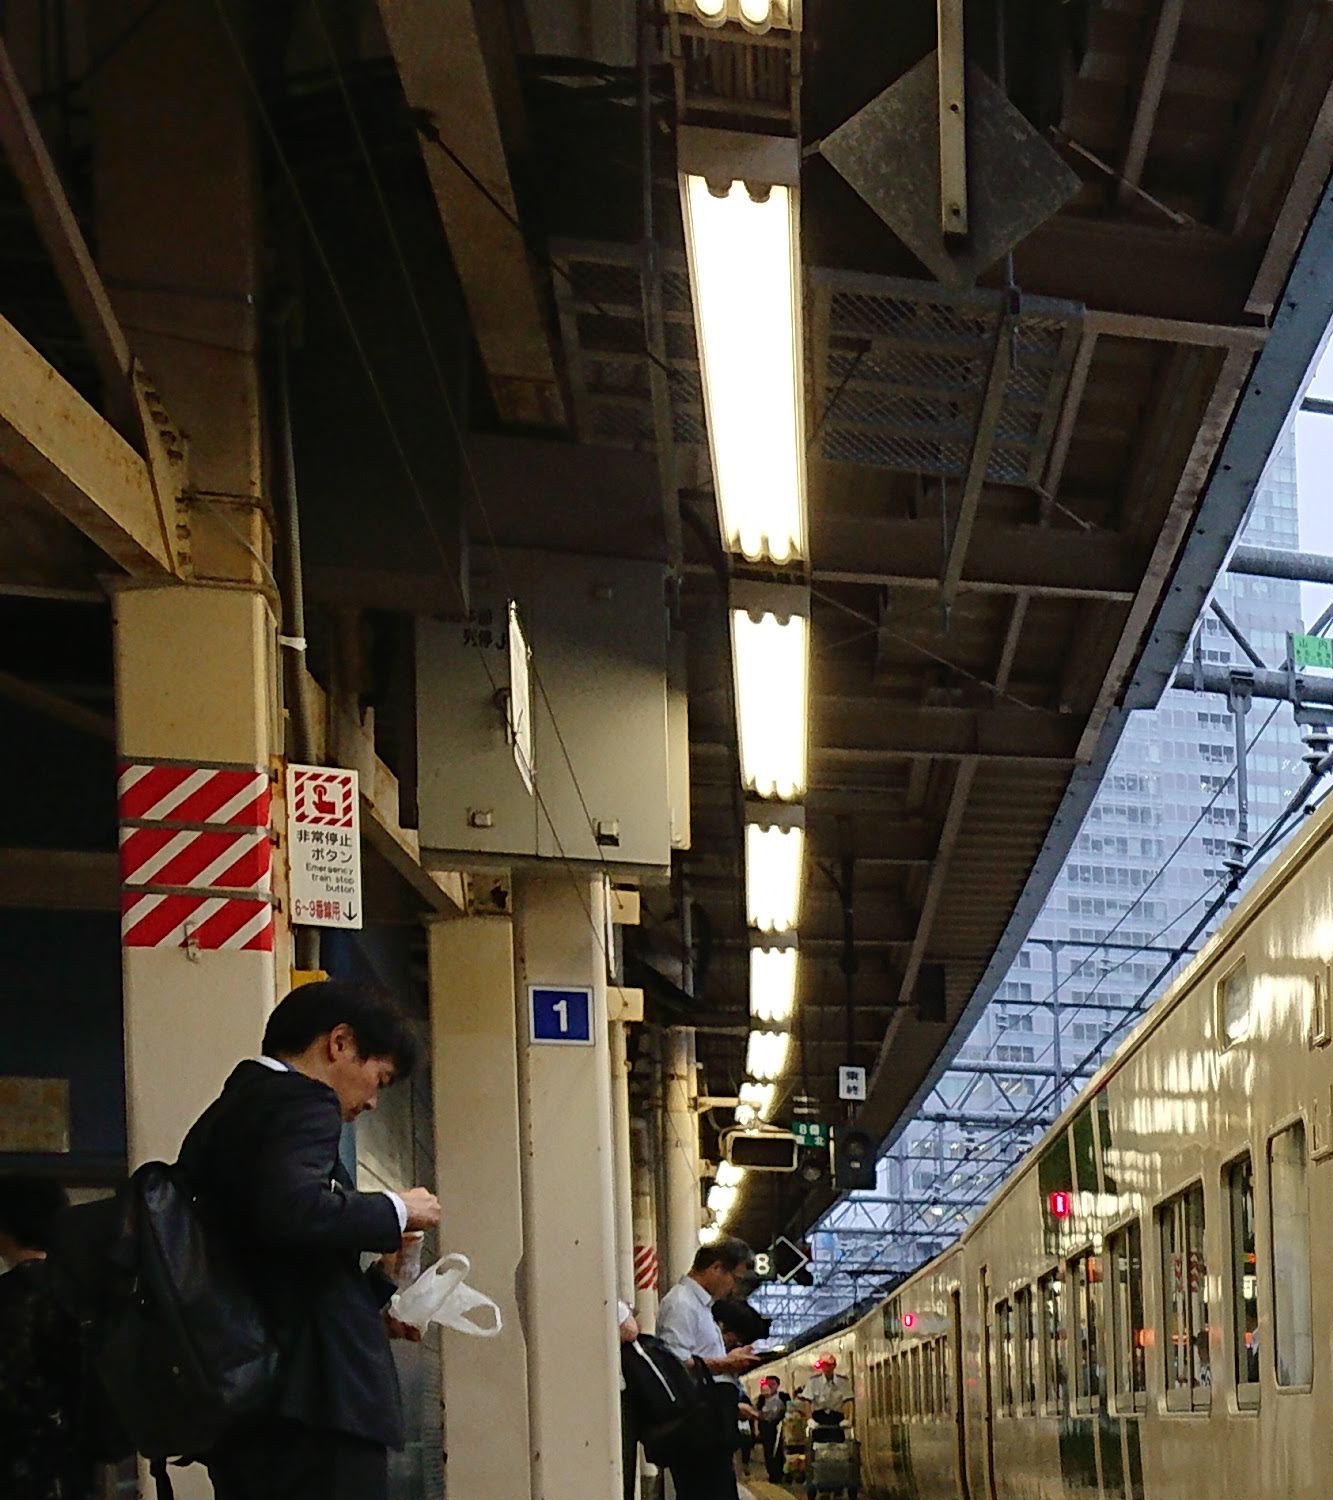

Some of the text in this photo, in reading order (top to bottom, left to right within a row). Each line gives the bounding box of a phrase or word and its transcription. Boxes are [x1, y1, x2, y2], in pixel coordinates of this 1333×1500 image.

[297, 829, 352, 847] 非常停止
[312, 848, 352, 863] ボタン
[306, 862, 353, 875] Emergency
[553, 1000, 567, 1032] 1
[754, 1253, 770, 1275] 8
